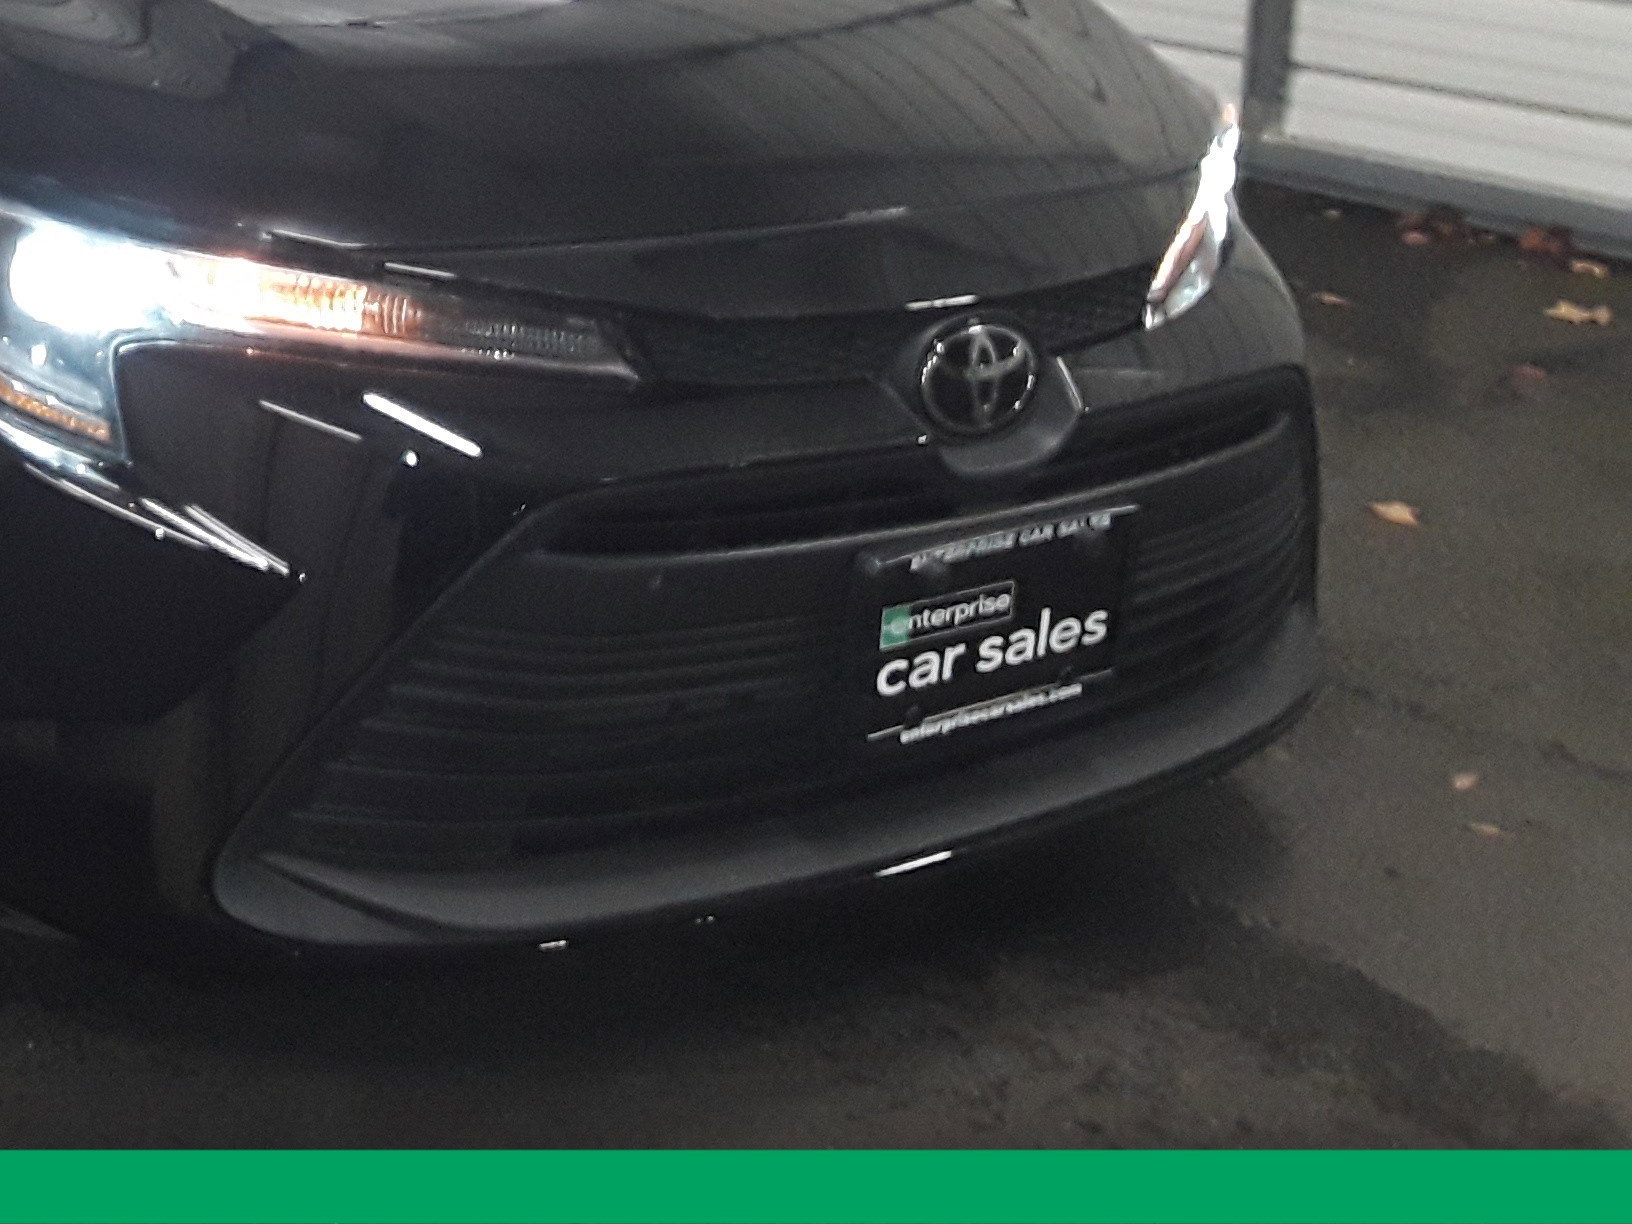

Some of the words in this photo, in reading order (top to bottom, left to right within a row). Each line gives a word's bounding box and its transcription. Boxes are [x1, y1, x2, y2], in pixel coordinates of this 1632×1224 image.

[884, 593, 1010, 633] enterprise
[876, 642, 966, 697] car
[975, 607, 1109, 672] sales
